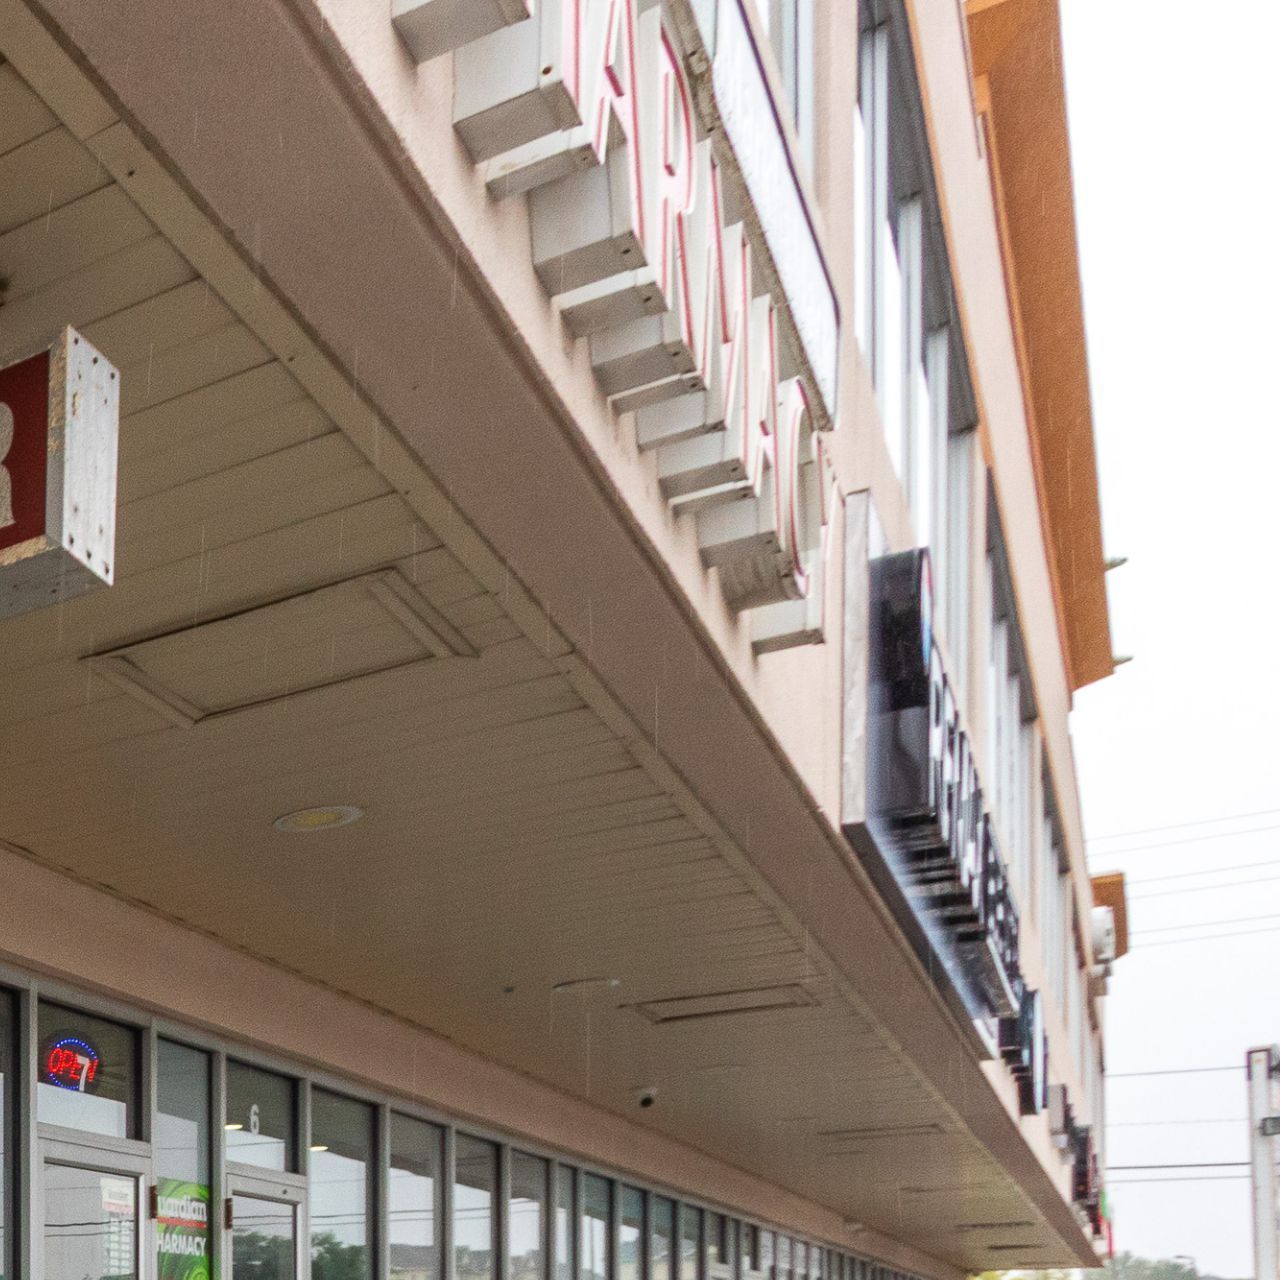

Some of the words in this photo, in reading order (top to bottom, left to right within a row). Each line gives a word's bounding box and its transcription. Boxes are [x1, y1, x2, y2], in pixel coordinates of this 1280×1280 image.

[77, 1055, 90, 1092] 7
[249, 1104, 260, 1137] 6
[157, 1195, 207, 1221] uardian
